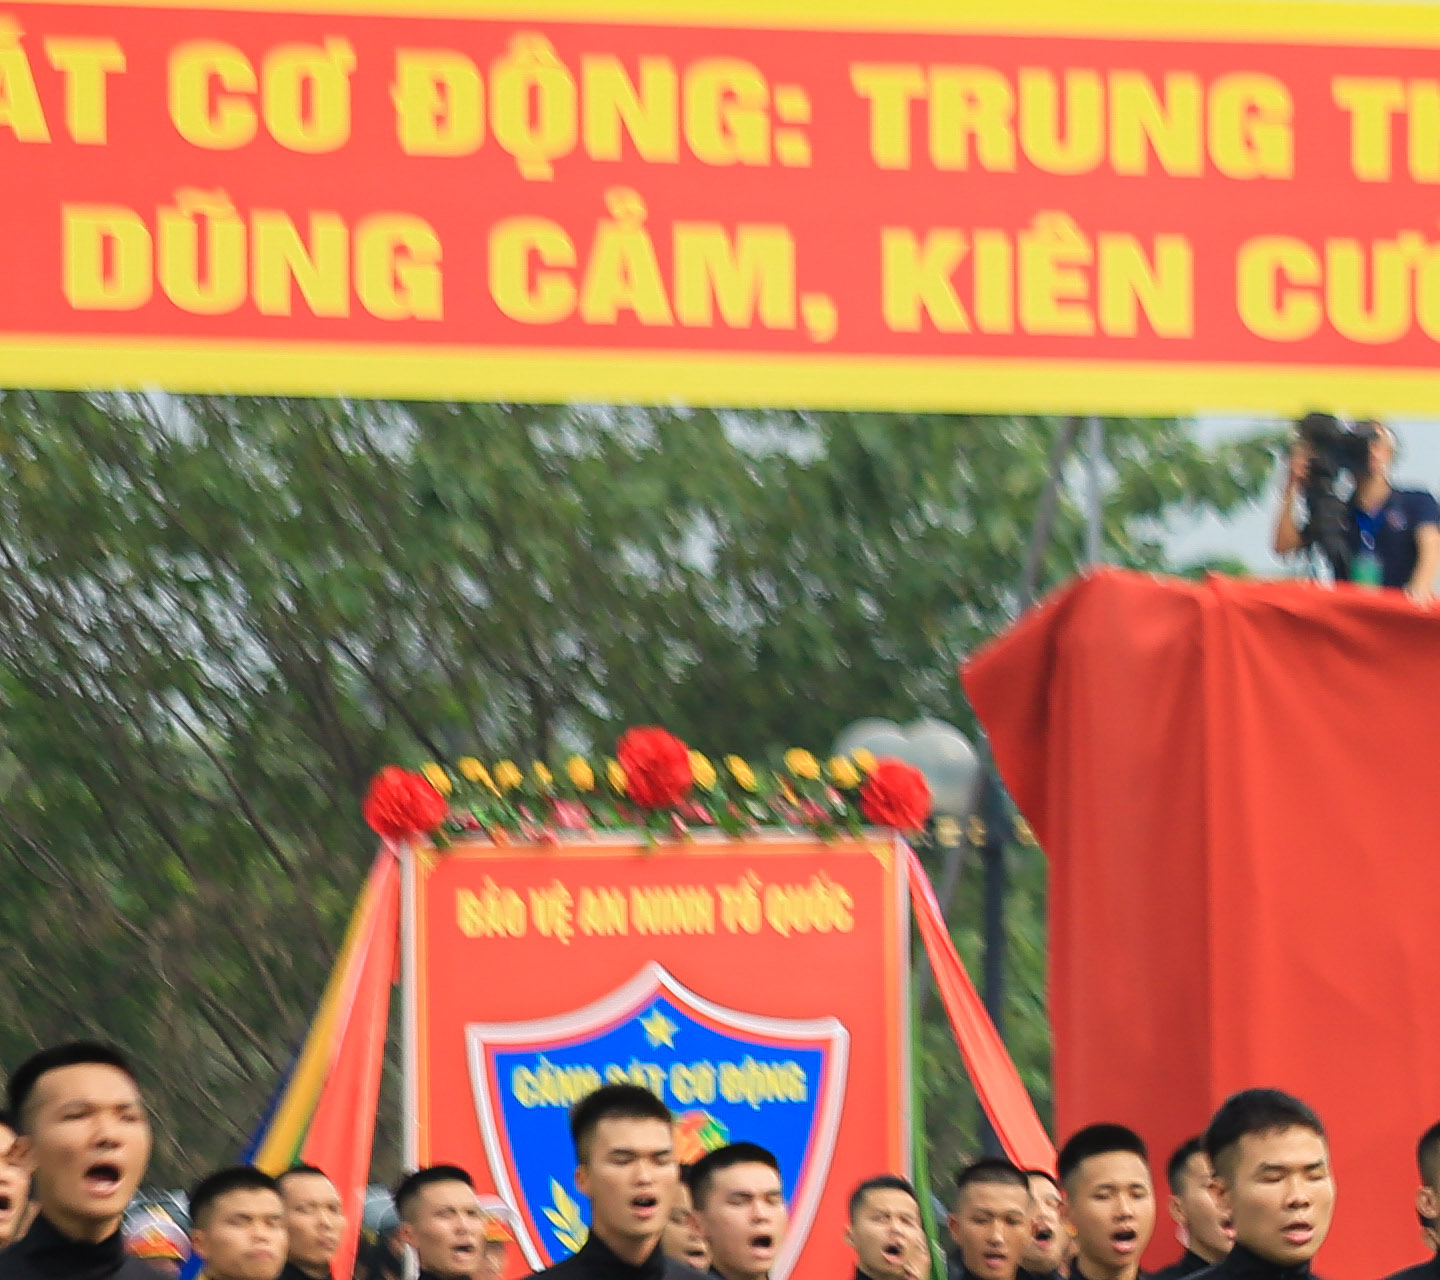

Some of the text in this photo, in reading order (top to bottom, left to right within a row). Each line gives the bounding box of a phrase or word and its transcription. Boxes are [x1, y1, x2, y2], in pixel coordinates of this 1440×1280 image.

[167, 37, 357, 153] CƠ
[390, 32, 811, 181] ĐỘNG:
[850, 63, 1295, 179] TRUNG
[63, 188, 443, 321] DŨNG
[488, 187, 838, 342] CẢM,
[881, 211, 1194, 339] KIÊN
[528, 879, 575, 946] VỆ
[576, 885, 629, 937] AN
[630, 884, 716, 936] NINH
[764, 870, 855, 938] QUỐC
[670, 1059, 717, 1105] CƠ
